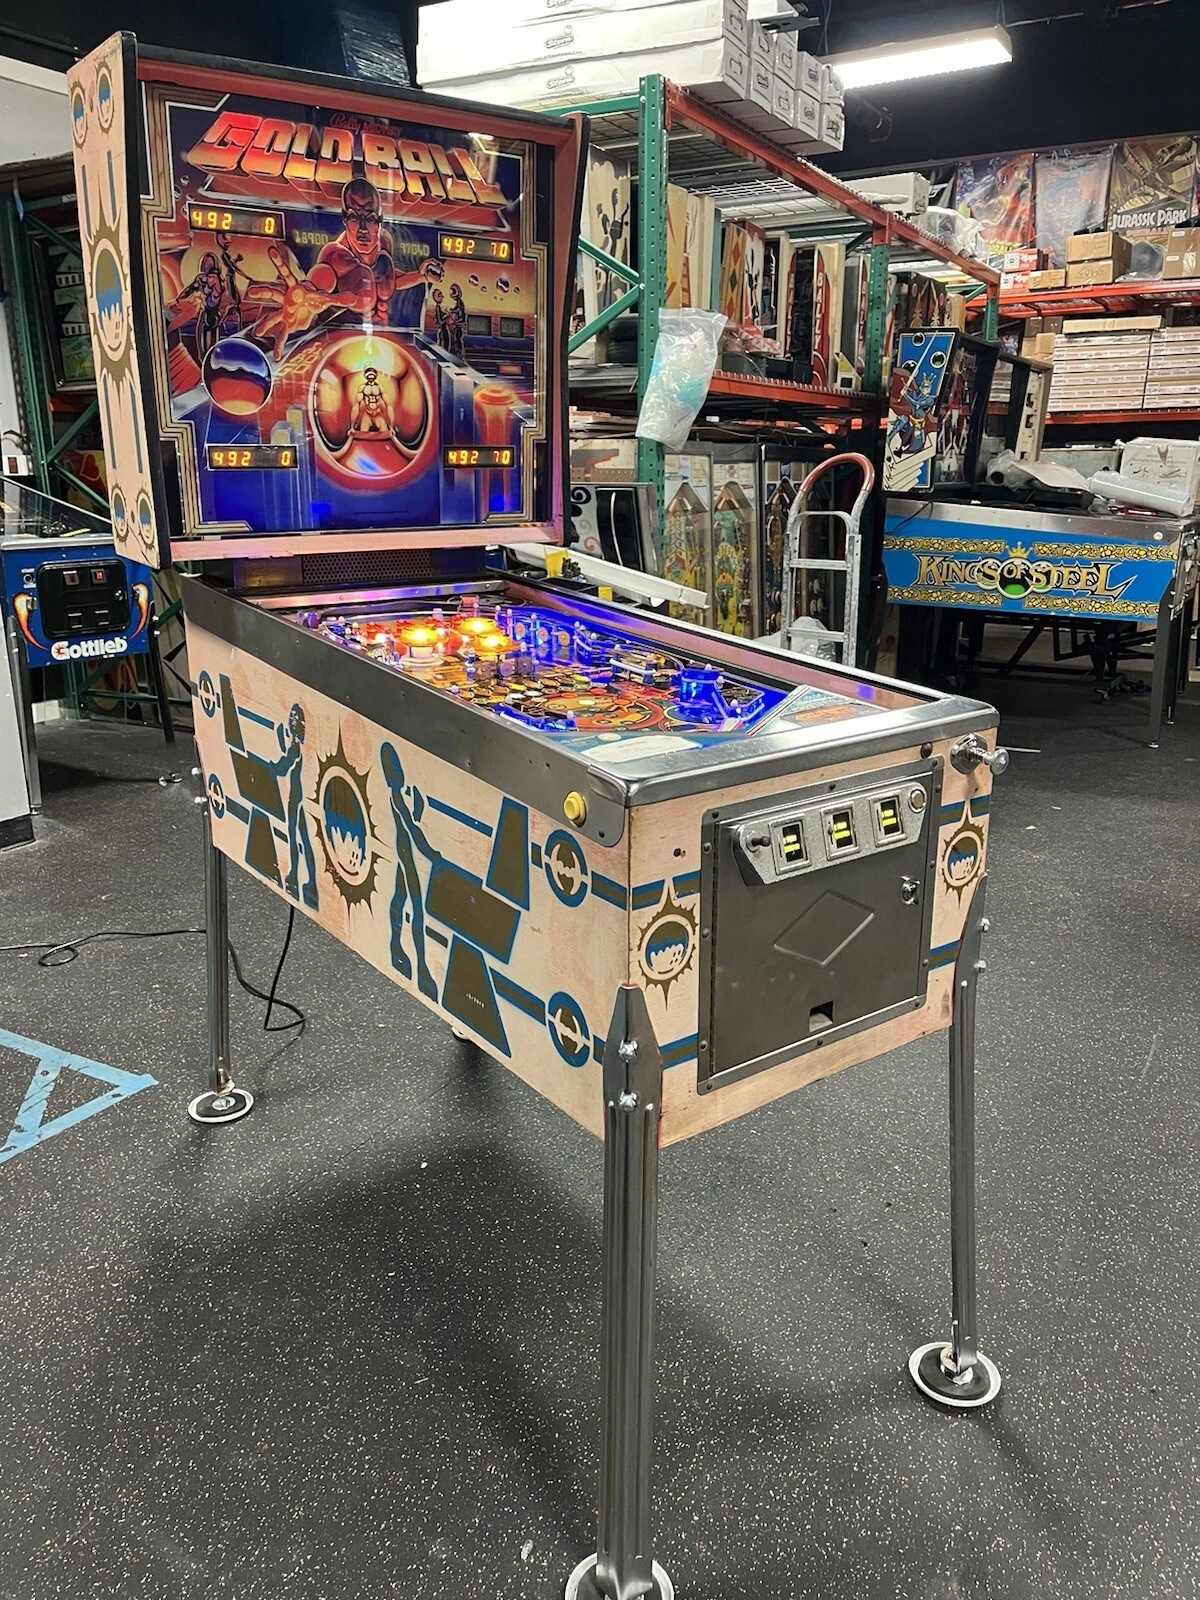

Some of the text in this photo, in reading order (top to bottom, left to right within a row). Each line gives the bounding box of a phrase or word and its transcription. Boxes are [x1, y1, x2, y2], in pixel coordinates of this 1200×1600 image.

[187, 111, 508, 205] GOLD BALL
[192, 210, 276, 235] 492 0
[1109, 207, 1188, 231] JURASSIC PARK
[443, 237, 509, 258] 492 70
[814, 271, 824, 350] BALLY
[213, 450, 292, 467] 492 0
[448, 449, 511, 465] 492 70
[912, 553, 1138, 602] KINGS OF STEEL
[51, 637, 128, 660] Gottlieb
